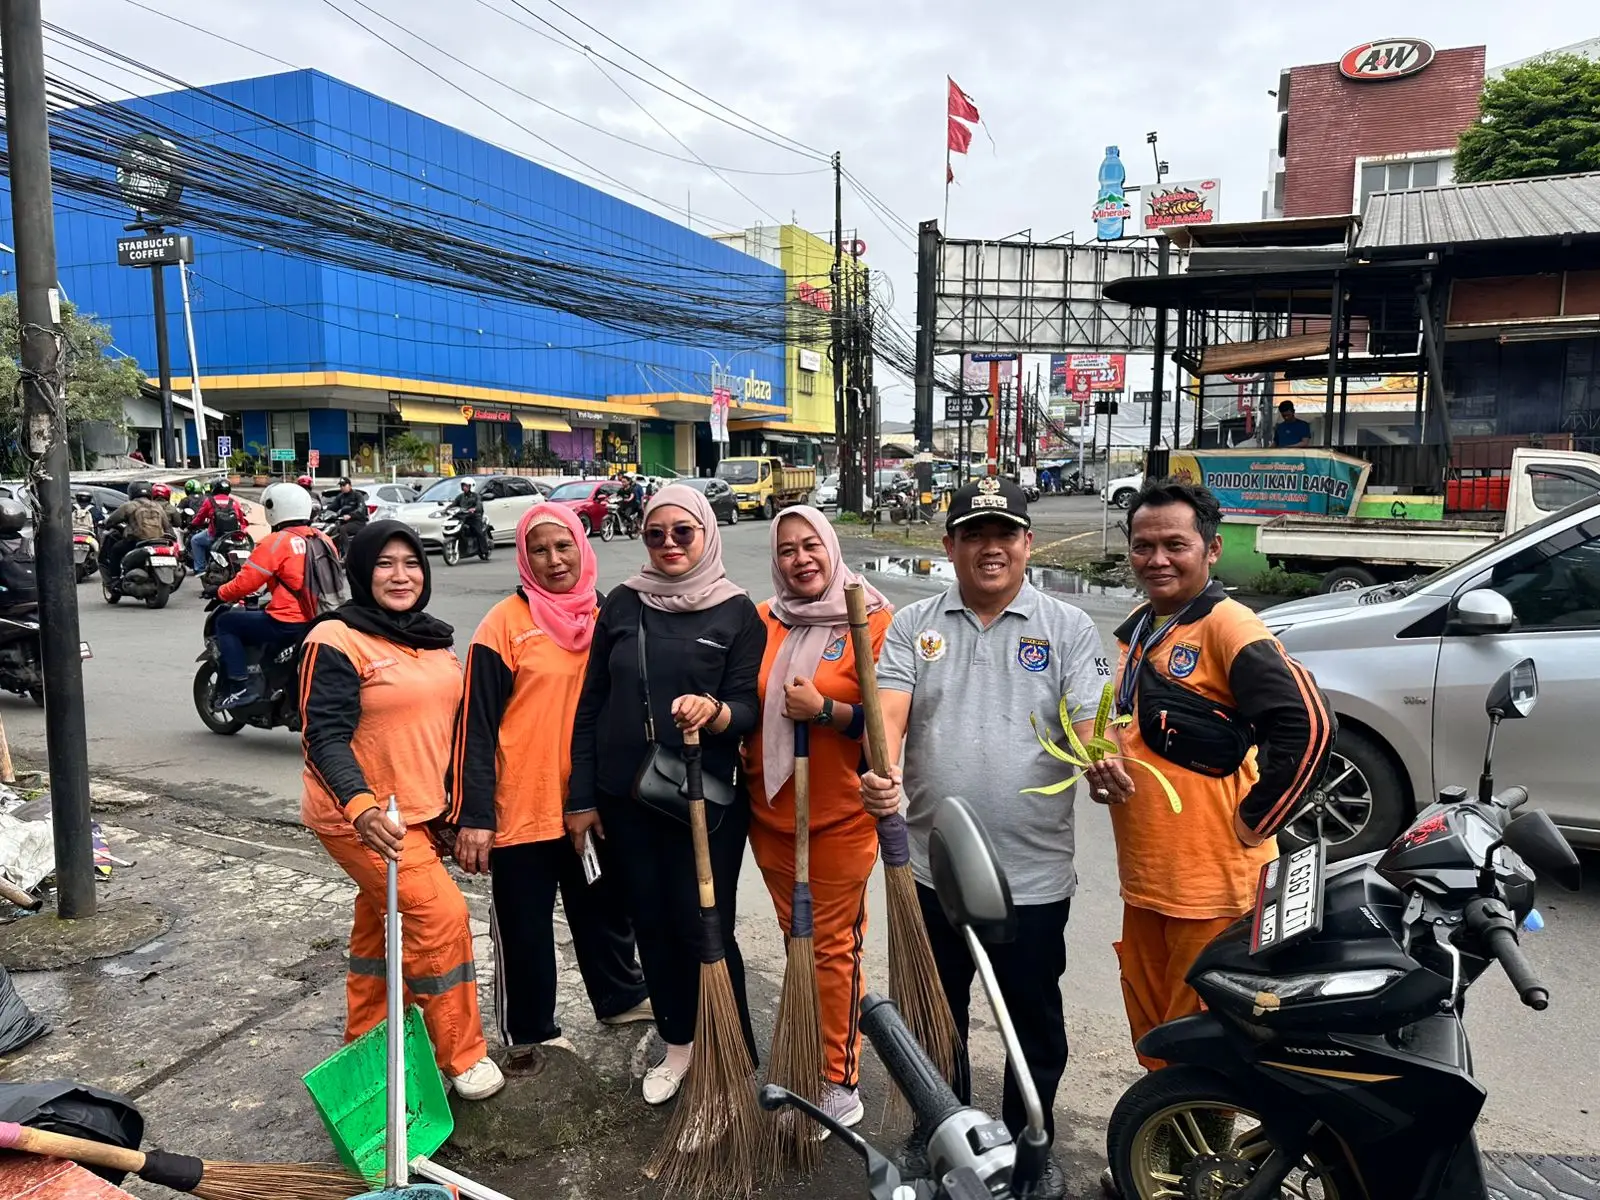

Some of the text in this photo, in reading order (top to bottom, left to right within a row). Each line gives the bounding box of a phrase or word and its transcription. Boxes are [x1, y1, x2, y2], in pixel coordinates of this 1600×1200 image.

[1356, 44, 1419, 73] A&W
[1105, 201, 1116, 210] Le
[1092, 207, 1130, 219] Minerale
[118, 237, 174, 252] STARBUCKS
[129, 248, 165, 260] COFFEE
[1100, 369, 1117, 381] 2X
[745, 368, 771, 401] plaza
[222, 446, 228, 454] P
[1207, 473, 1349, 500] PONDOK IKAN BAKAR
[1291, 849, 1311, 863] B
[1287, 863, 1311, 900] 6367
[1284, 1046, 1355, 1056] HONDA
